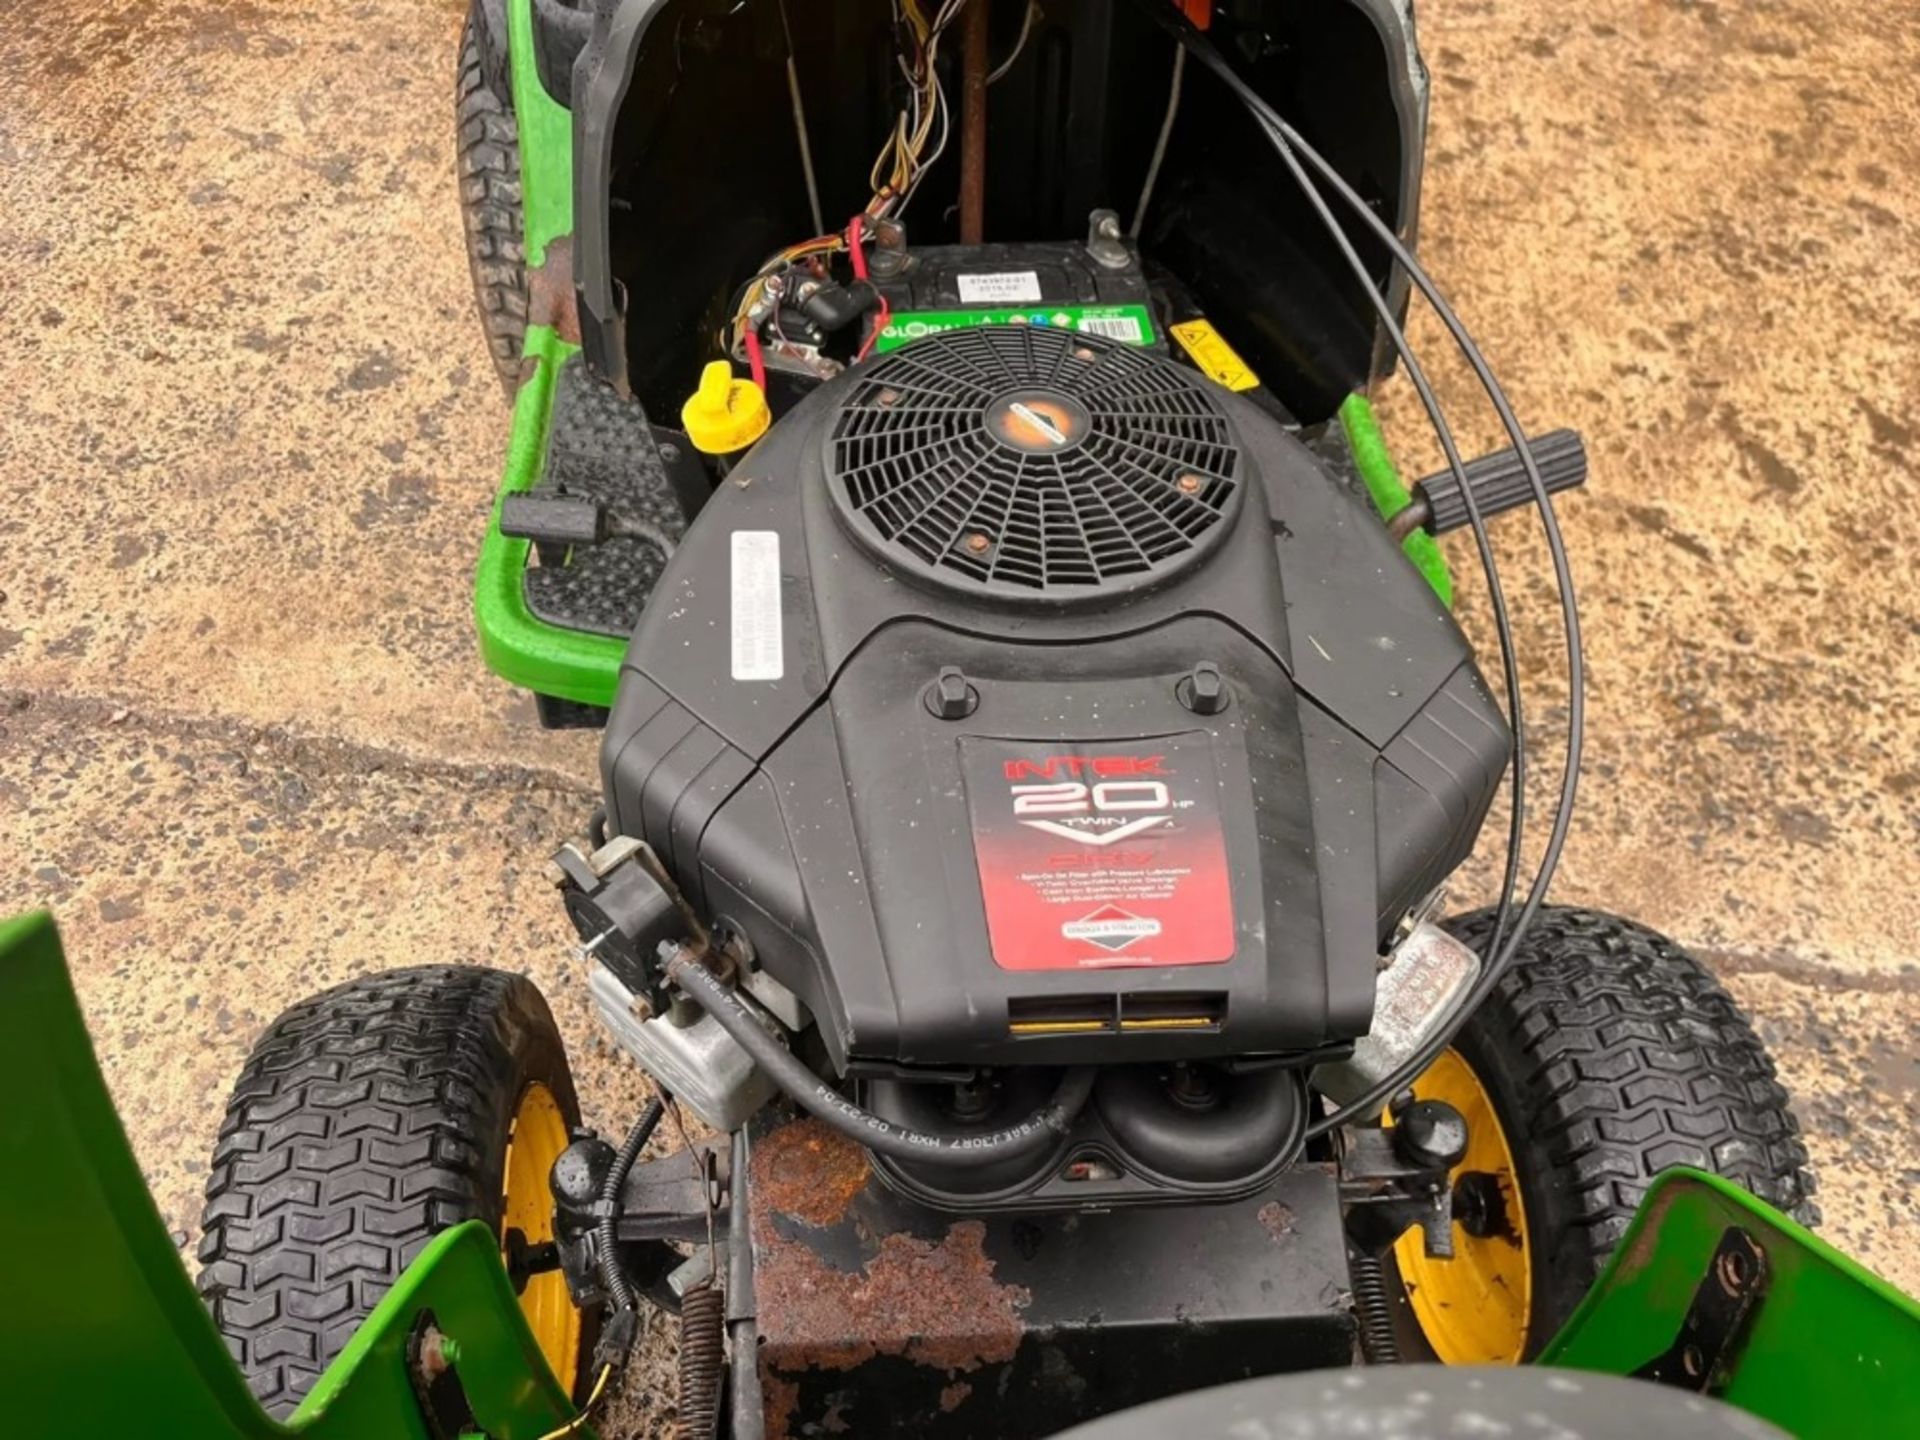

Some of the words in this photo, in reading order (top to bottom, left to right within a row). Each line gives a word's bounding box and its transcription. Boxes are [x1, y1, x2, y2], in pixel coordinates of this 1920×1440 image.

[1004, 756, 1166, 779] INTEK
[1011, 781, 1170, 815] 20
[1061, 817, 1127, 826] TWIN
